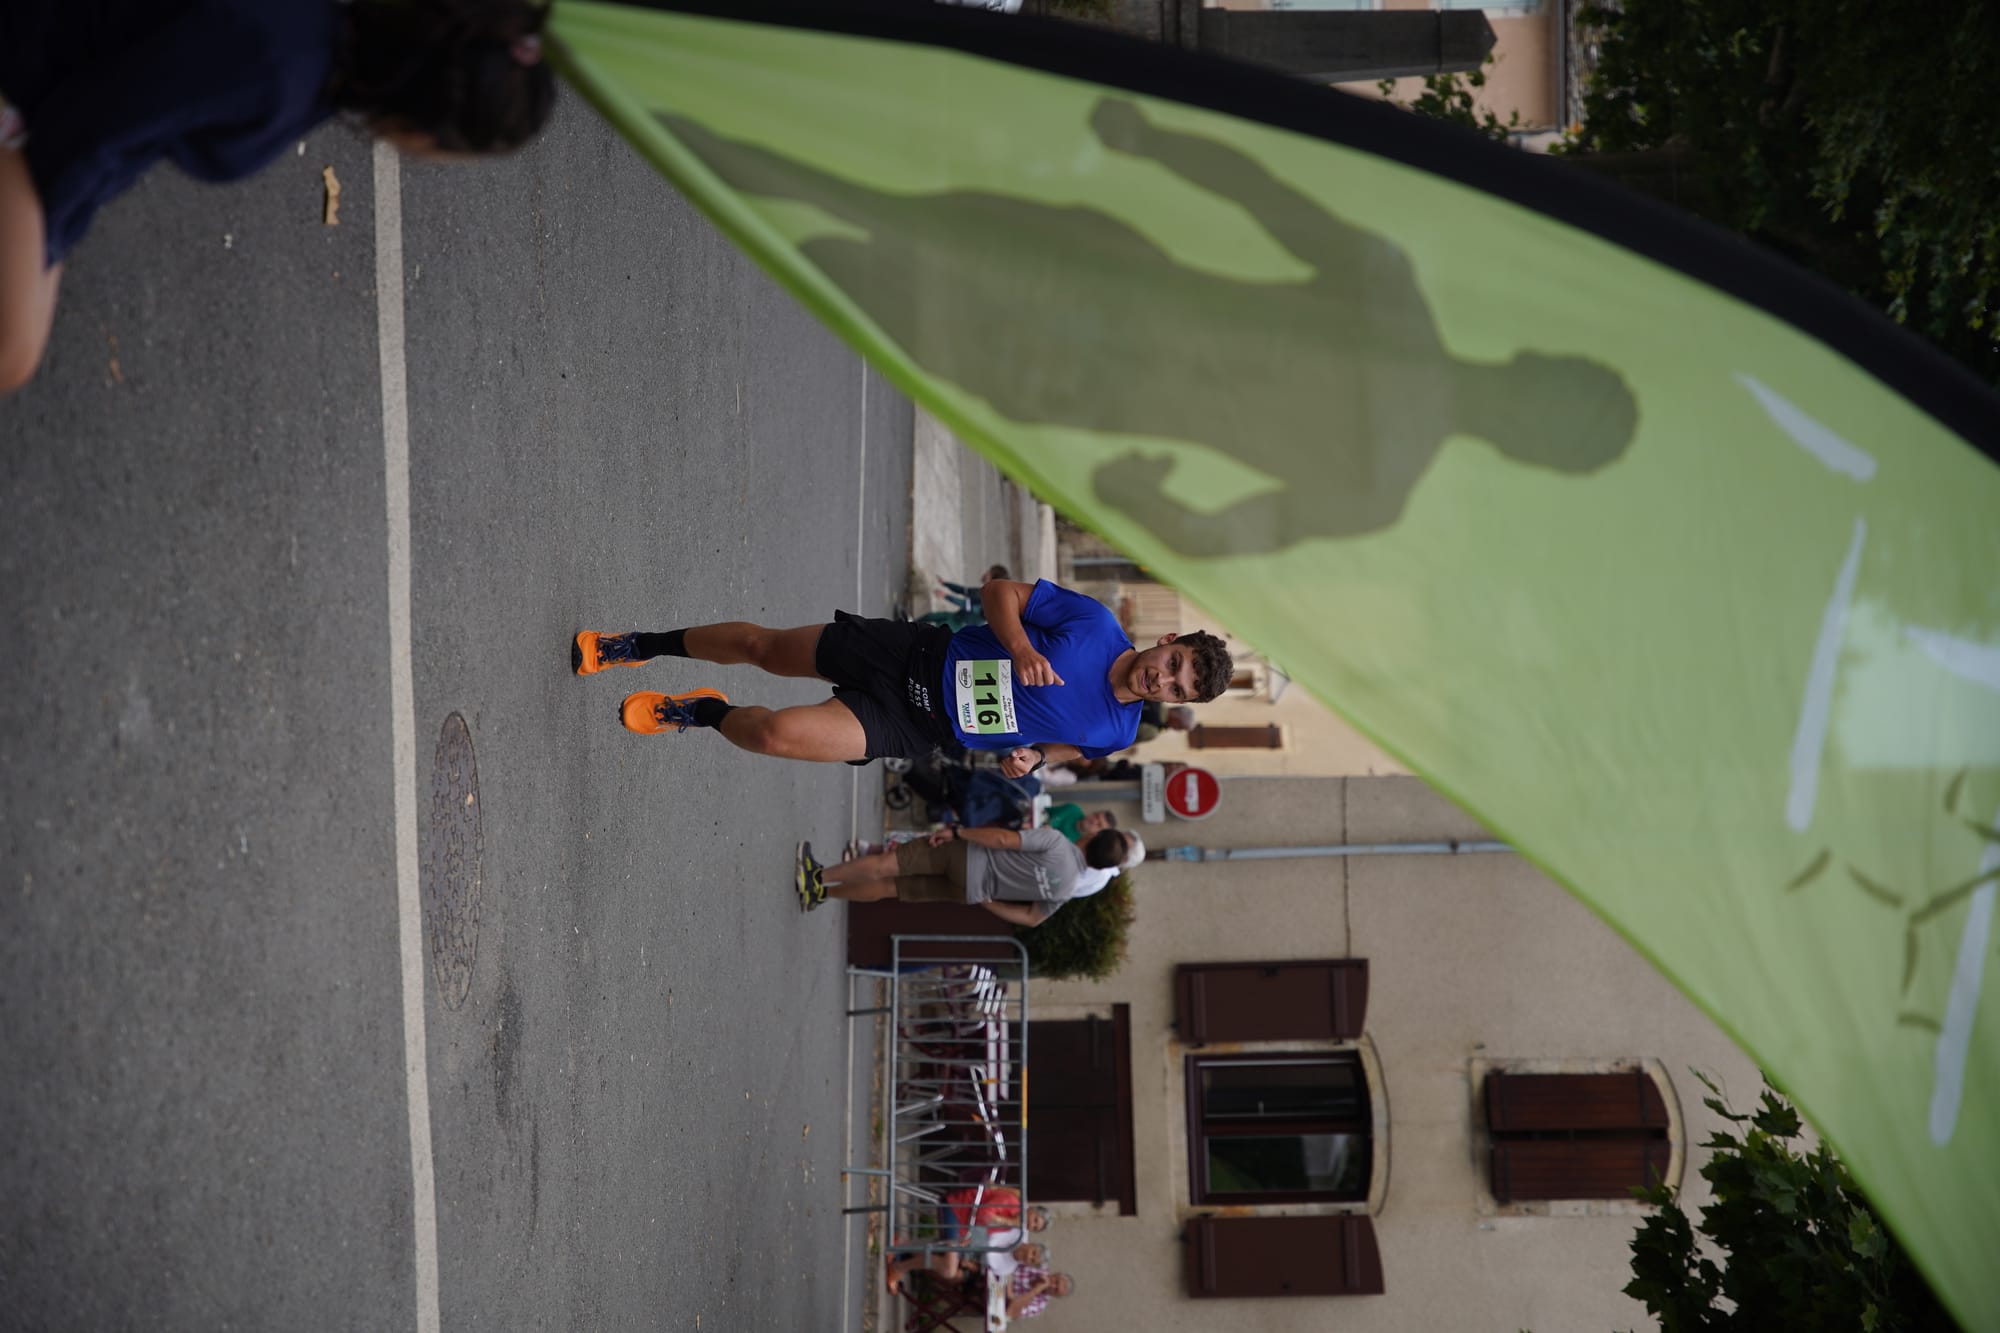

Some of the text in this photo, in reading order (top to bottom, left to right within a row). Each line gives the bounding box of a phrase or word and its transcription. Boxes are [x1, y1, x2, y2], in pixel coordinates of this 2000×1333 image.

[914, 683, 922, 707] RESS
[922, 687, 931, 712] COMP
[975, 673, 1000, 726] 116
